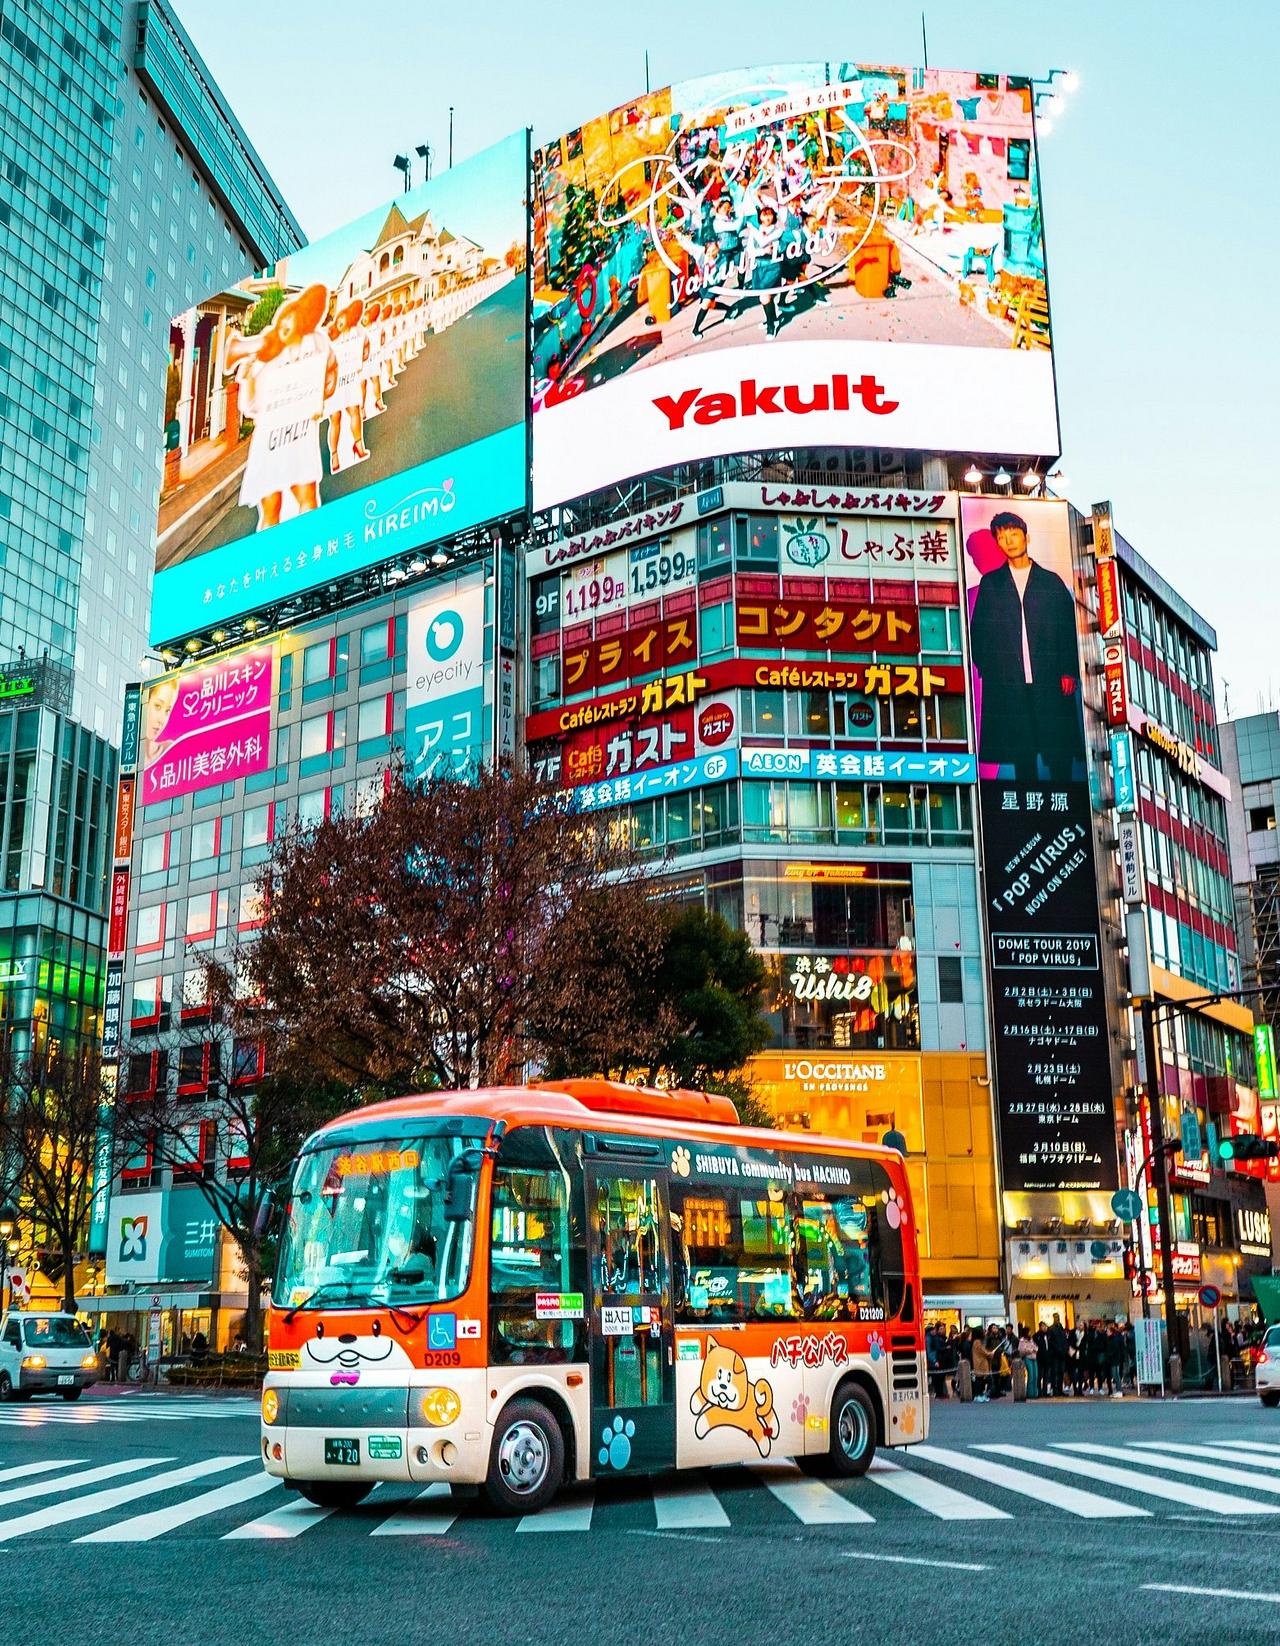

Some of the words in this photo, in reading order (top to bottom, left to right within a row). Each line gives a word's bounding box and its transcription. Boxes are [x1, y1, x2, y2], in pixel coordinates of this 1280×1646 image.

[652, 374, 899, 430] Yakult
[364, 488, 457, 545] KIREIMO
[761, 487, 946, 514] しゃぶしゃぶバイキング
[545, 501, 684, 566] しゃぶしゃぶバイキング
[841, 528, 949, 564] しゃぶ葉
[203, 530, 356, 604] あなたを叶える全身脱毛
[631, 552, 696, 596] 1,599円
[535, 591, 558, 616] 9F
[566, 576, 624, 618] 1,199円
[739, 606, 912, 642] コンタクト
[565, 621, 694, 684] プライス
[200, 660, 267, 698] 品川スキン
[415, 659, 473, 693] eyecity
[864, 664, 945, 696] ガスト
[199, 686, 259, 721] クリニック
[642, 672, 706, 715] ガスト
[1110, 679, 1122, 717] ガスト
[703, 721, 730, 736] ガスト
[159, 734, 262, 790] 品川美容外科
[569, 745, 603, 768] Café
[606, 723, 686, 776] ガスト
[751, 754, 801, 770] AEON
[816, 753, 970, 776] 英会話イーオン
[534, 756, 560, 784] 7F
[706, 760, 724, 776] 6F
[580, 765, 698, 808] 英会話イーオン
[1001, 790, 1069, 812] 星野源
[119, 795, 130, 855] 東京スター銀行
[1004, 854, 1021, 873] NEW
[1020, 833, 1042, 858] ALBUM
[1123, 829, 1137, 897] 渋谷駅前ビル
[1025, 889, 1048, 916] NOW
[1047, 875, 1063, 892] ON
[1060, 849, 1088, 879] SALE!
[998, 939, 1030, 950] DOME
[1033, 939, 1062, 951] TOUR
[1066, 940, 1091, 951] 2019
[795, 956, 830, 974] 渋谷
[790, 973, 873, 1001] Ushi8
[1018, 998, 1082, 1008] 京セラドーム大阪
[104, 972, 121, 1041] 加藤眼科
[1029, 1037, 1077, 1046] ナゴヤドーム
[784, 1060, 887, 1080] L'OCCITANE
[804, 1083, 815, 1091] EN
[1035, 1075, 1076, 1084] 札幌ドーム
[1038, 1114, 1079, 1123] 東京ドーム
[696, 1154, 739, 1176] SHIBUYA
[741, 1162, 792, 1184] community
[794, 1163, 812, 1182] bus
[812, 1165, 851, 1185] HACHIKO
[1238, 1208, 1270, 1245] LUSH
[605, 1310, 630, 1324] 出入口
[860, 1308, 884, 1320] D21209
[424, 1352, 461, 1367] D209
[771, 1330, 849, 1368] ハチ公バス
